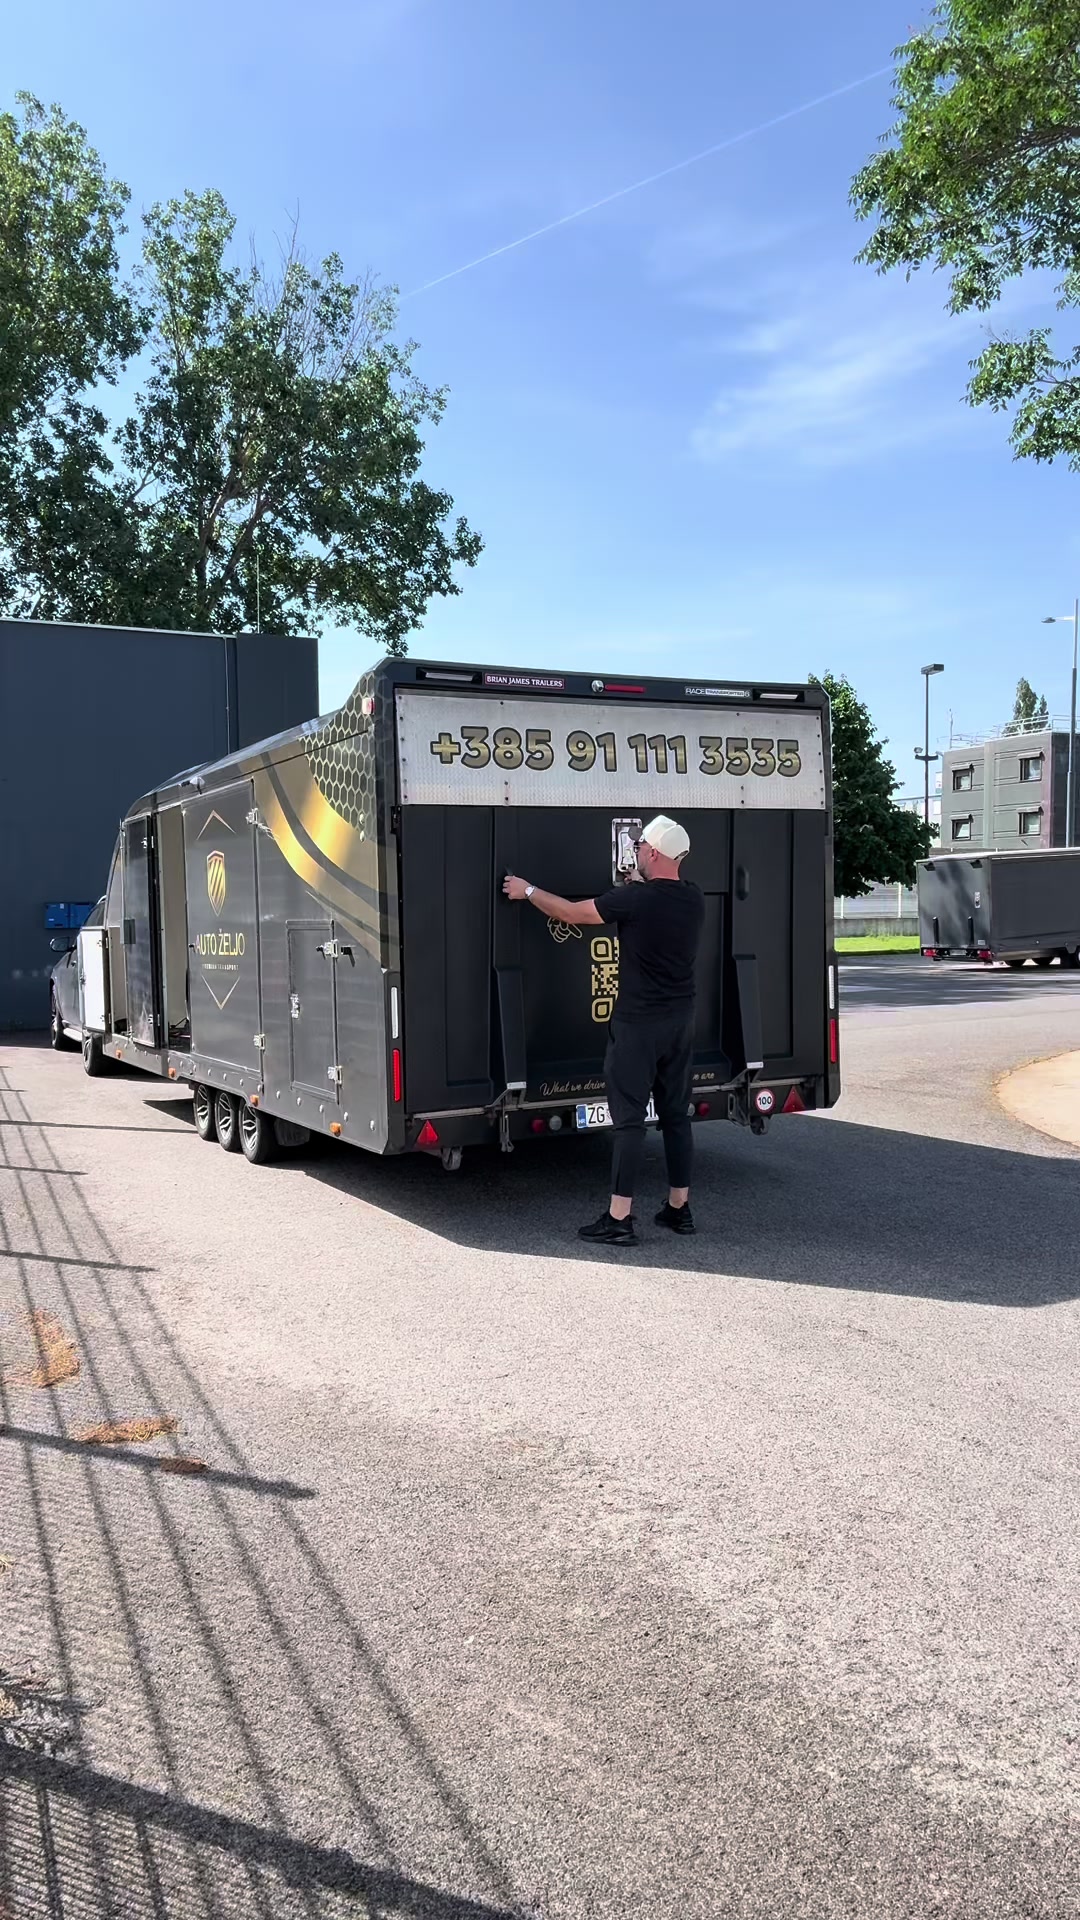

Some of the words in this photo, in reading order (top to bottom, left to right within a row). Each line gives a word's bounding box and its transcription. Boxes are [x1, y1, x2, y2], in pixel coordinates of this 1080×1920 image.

[486, 675, 508, 684] BRIAN
[508, 677, 530, 685] JAMES
[531, 678, 563, 687] TRAILERS
[685, 687, 705, 695] RACE
[430, 725, 554, 770] +385
[566, 730, 617, 772] 91
[627, 733, 688, 774] 111
[699, 736, 801, 777] 3535
[194, 933, 217, 956] AUTO
[218, 928, 245, 956] ŽELJO
[540, 1081, 570, 1096] What
[583, 1079, 606, 1090] drive
[700, 1072, 715, 1080] are
[758, 1096, 772, 1105] 100
[587, 1106, 605, 1124] ZG
